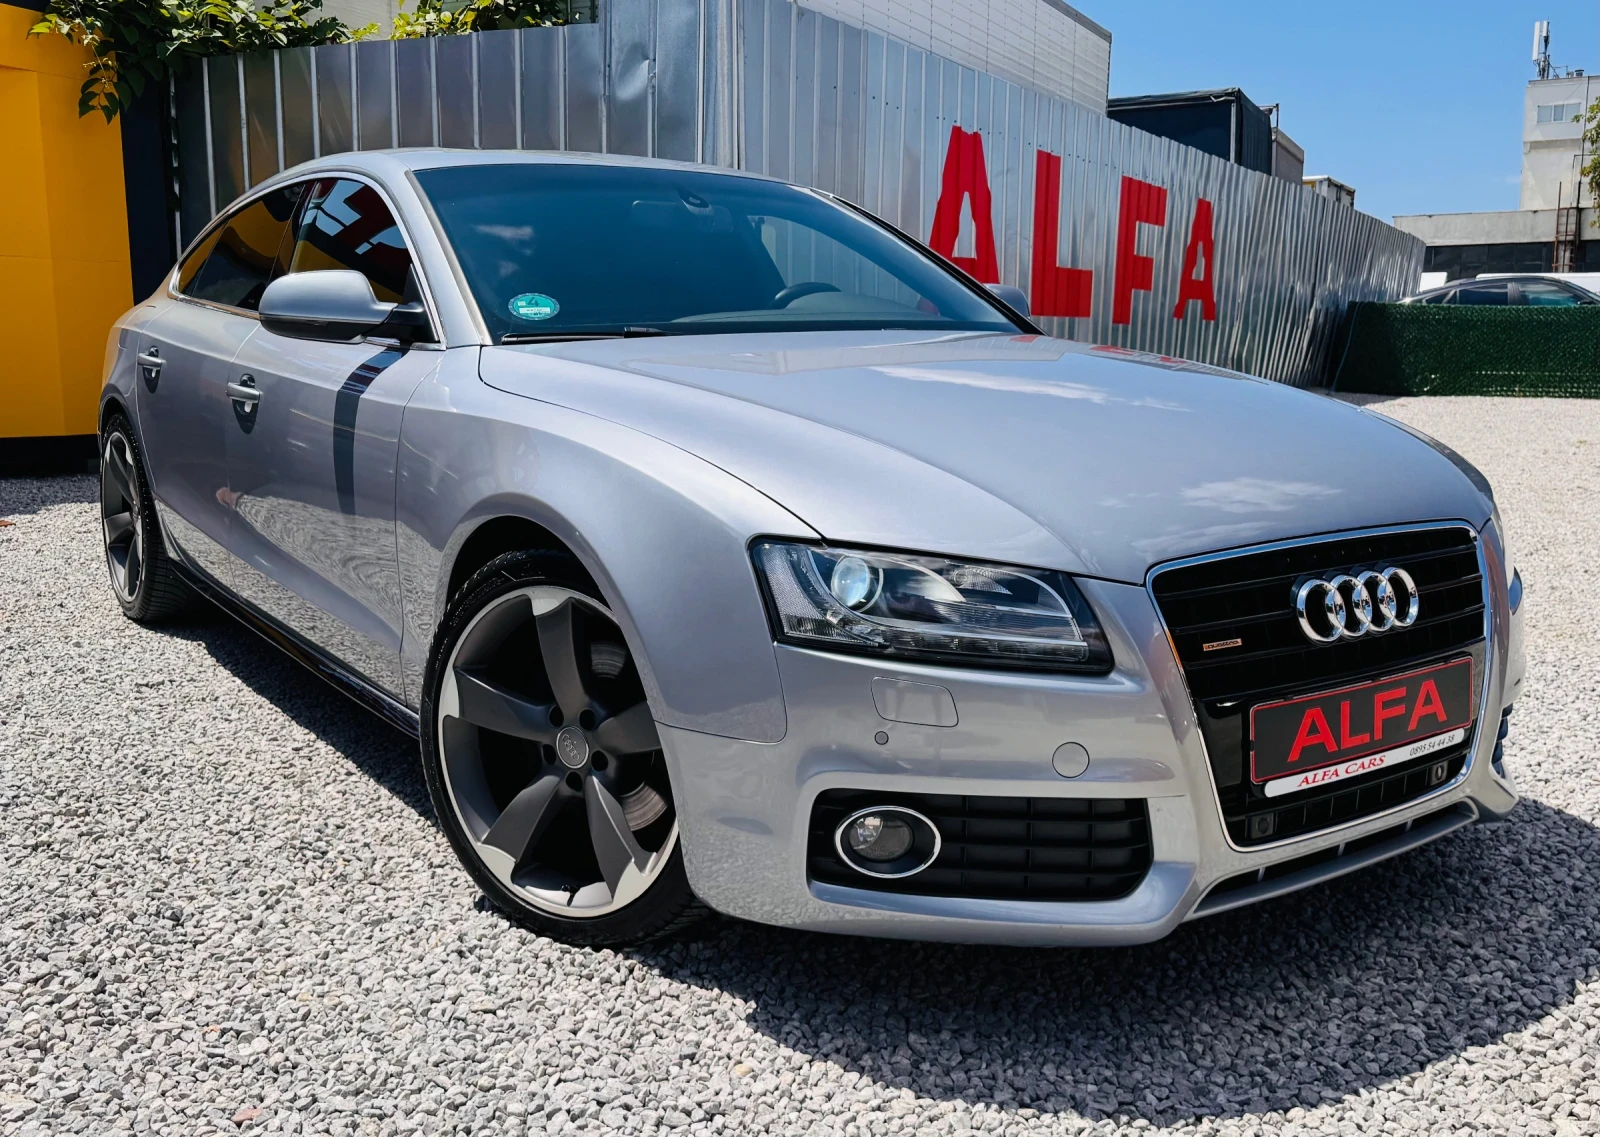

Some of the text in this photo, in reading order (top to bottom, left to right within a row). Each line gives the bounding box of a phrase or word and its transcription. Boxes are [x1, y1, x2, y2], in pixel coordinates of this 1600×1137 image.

[929, 125, 1216, 325] ALFA
[1287, 679, 1448, 763] ALFA
[1437, 737, 1446, 747] 44
[1297, 754, 1386, 787] ALFA CARS
